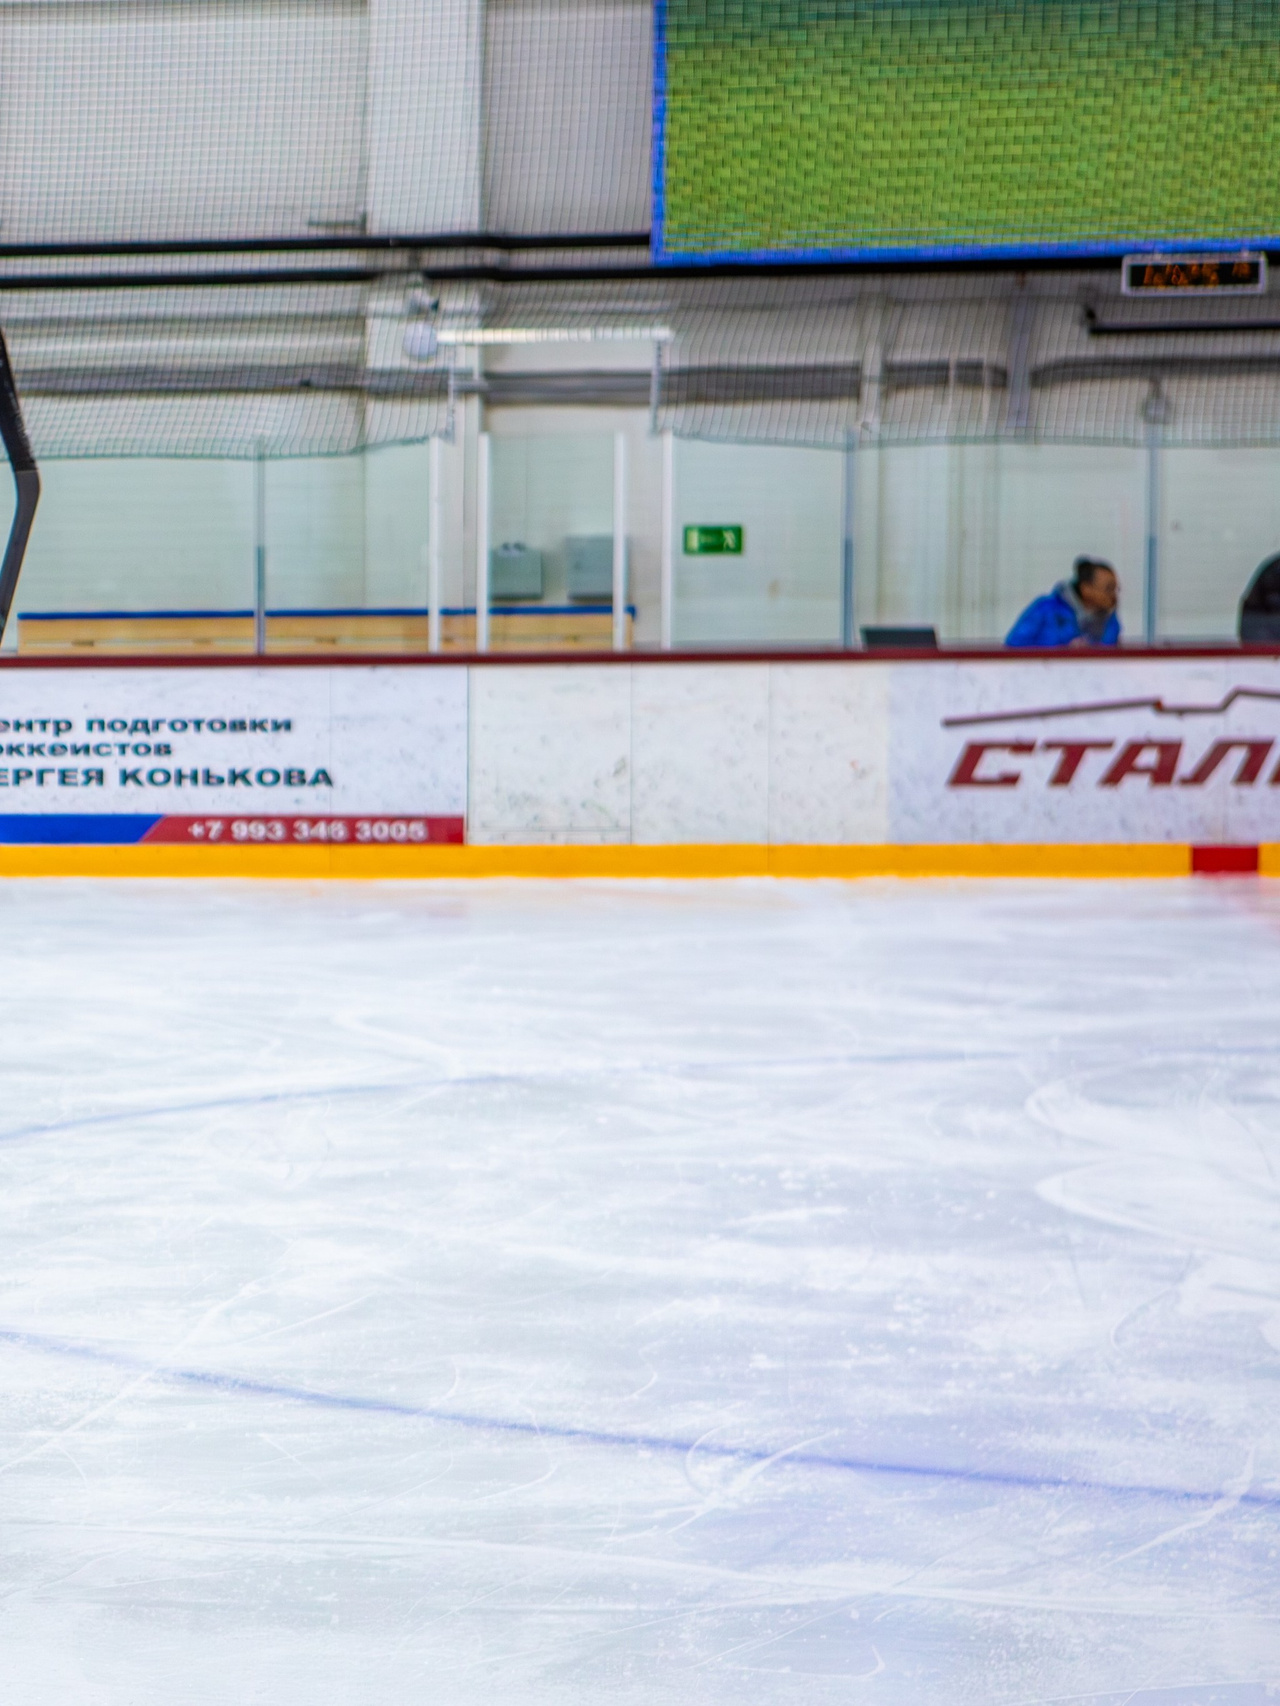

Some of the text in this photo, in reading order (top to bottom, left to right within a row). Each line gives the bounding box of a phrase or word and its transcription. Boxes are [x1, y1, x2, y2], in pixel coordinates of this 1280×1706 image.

[86, 717, 292, 737] подготовки
[948, 738, 1280, 788] СТАЛ
[119, 768, 333, 787] КОНЬКОВА
[188, 820, 224, 840] +7
[231, 820, 286, 841] 993
